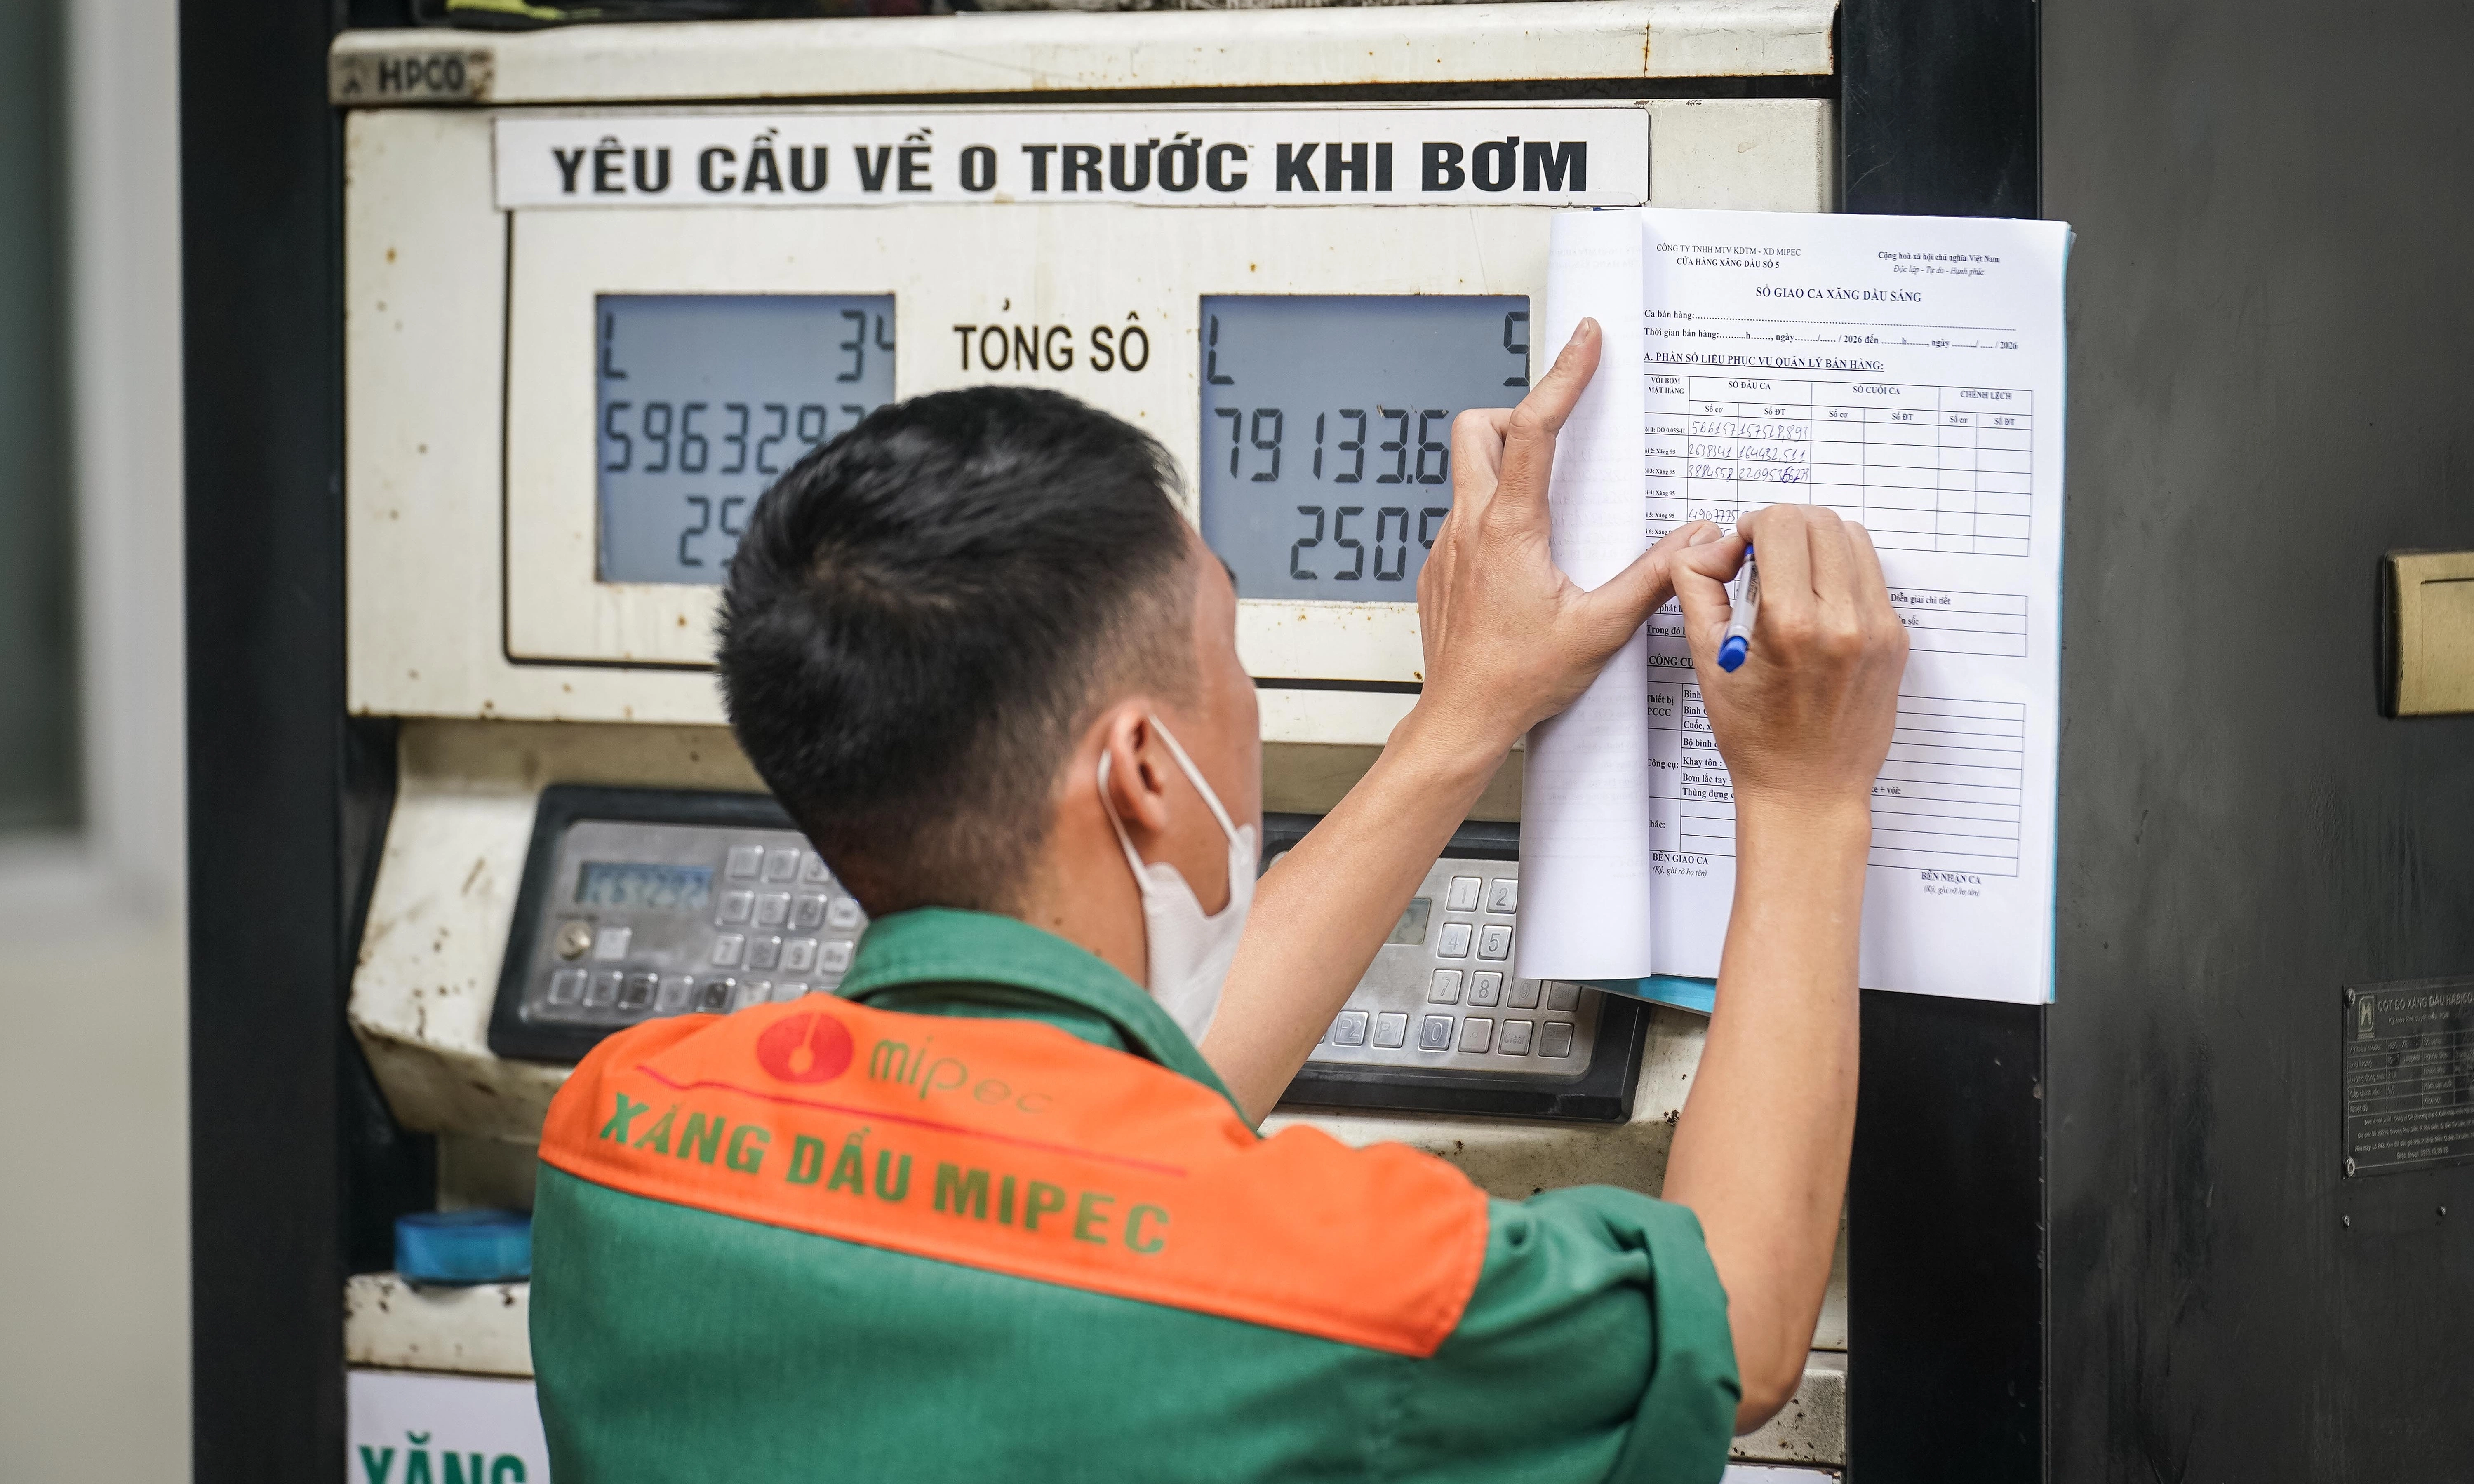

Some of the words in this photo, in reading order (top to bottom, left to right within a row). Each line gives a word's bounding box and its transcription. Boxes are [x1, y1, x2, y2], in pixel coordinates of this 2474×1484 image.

[553, 136, 671, 195] YÊU
[698, 127, 829, 195] CẦU
[853, 127, 933, 194] VỀ
[1021, 131, 1248, 193] TRƯỚC
[1275, 141, 1393, 192] KHI
[1421, 136, 1587, 192] BƠM
[1657, 242, 1678, 252] CÔNG
[1677, 256, 1693, 265] CỬA
[1696, 257, 1718, 266] HÀNG
[1719, 257, 1742, 267] XĂNG
[1878, 251, 1897, 261] Cộng
[1969, 254, 1983, 263] Việt
[1756, 284, 1771, 297] SỔ
[1774, 288, 1804, 298] GIAO
[1807, 289, 1823, 299] CA
[1826, 286, 1860, 301] XĂNG
[1890, 289, 1922, 303] SÁNG
[1644, 310, 1655, 318] Ca
[1644, 327, 1662, 336] Thời
[1664, 330, 1680, 339] gian
[1844, 335, 1862, 343] 2026
[1864, 334, 1879, 344] đến
[1999, 341, 2018, 350] 2026
[1207, 313, 1235, 385] L
[1701, 352, 1724, 365] LIỆU
[1728, 355, 1755, 366] PHỤC
[1758, 356, 1772, 367] VỤ
[1809, 355, 1822, 367] LÝ
[1826, 357, 1846, 369] BÁN
[1850, 358, 1884, 370] HÀNG:
[1705, 404, 1714, 413] Số
[1764, 406, 1773, 415] Số
[1214, 407, 1449, 484] 79133.6
[1891, 592, 1908, 603] Diễn
[1659, 604, 1677, 614] phát
[1647, 624, 1669, 636] Trong
[1671, 627, 1681, 635] đó
[1649, 653, 1678, 666] CÔNG
[1667, 695, 1674, 706] bị
[1684, 690, 1702, 699] Bình
[1648, 707, 1671, 716] PCCC
[1684, 706, 1701, 715] Bình
[1683, 737, 1693, 749] Bộ
[1695, 739, 1712, 748] bình
[1667, 762, 1679, 770] cụ:
[1683, 756, 1703, 768] Khay
[1705, 758, 1717, 767] tôn
[1683, 773, 1700, 782] Bơm
[1702, 772, 1713, 783] lắc
[1715, 775, 1727, 786] tay
[1682, 787, 1707, 799] Thùng
[1709, 789, 1729, 800] đựng
[1652, 850, 1670, 862] BÊN
[1672, 854, 1694, 864] GIAO
[1696, 856, 1709, 865] CA
[1652, 865, 1665, 874] (Ký,
[1667, 866, 1677, 876] ghi
[1686, 868, 1694, 876] họ
[1696, 869, 1707, 878] tên)
[1968, 875, 1982, 884] CA
[1460, 883, 1468, 904] 1
[1495, 886, 1509, 906] 2
[1447, 932, 1459, 950] 4
[1488, 932, 1501, 953] 5
[1441, 978, 1451, 996] 7
[1478, 979, 1490, 998] 8
[1519, 981, 1531, 1000] 9
[1340, 1019, 1362, 1038] P2
[1378, 1021, 1399, 1039] P1
[1504, 1031, 1526, 1045] Clear
[870, 1035, 1054, 1114] mipec
[932, 1161, 1171, 1255] MIPEC
